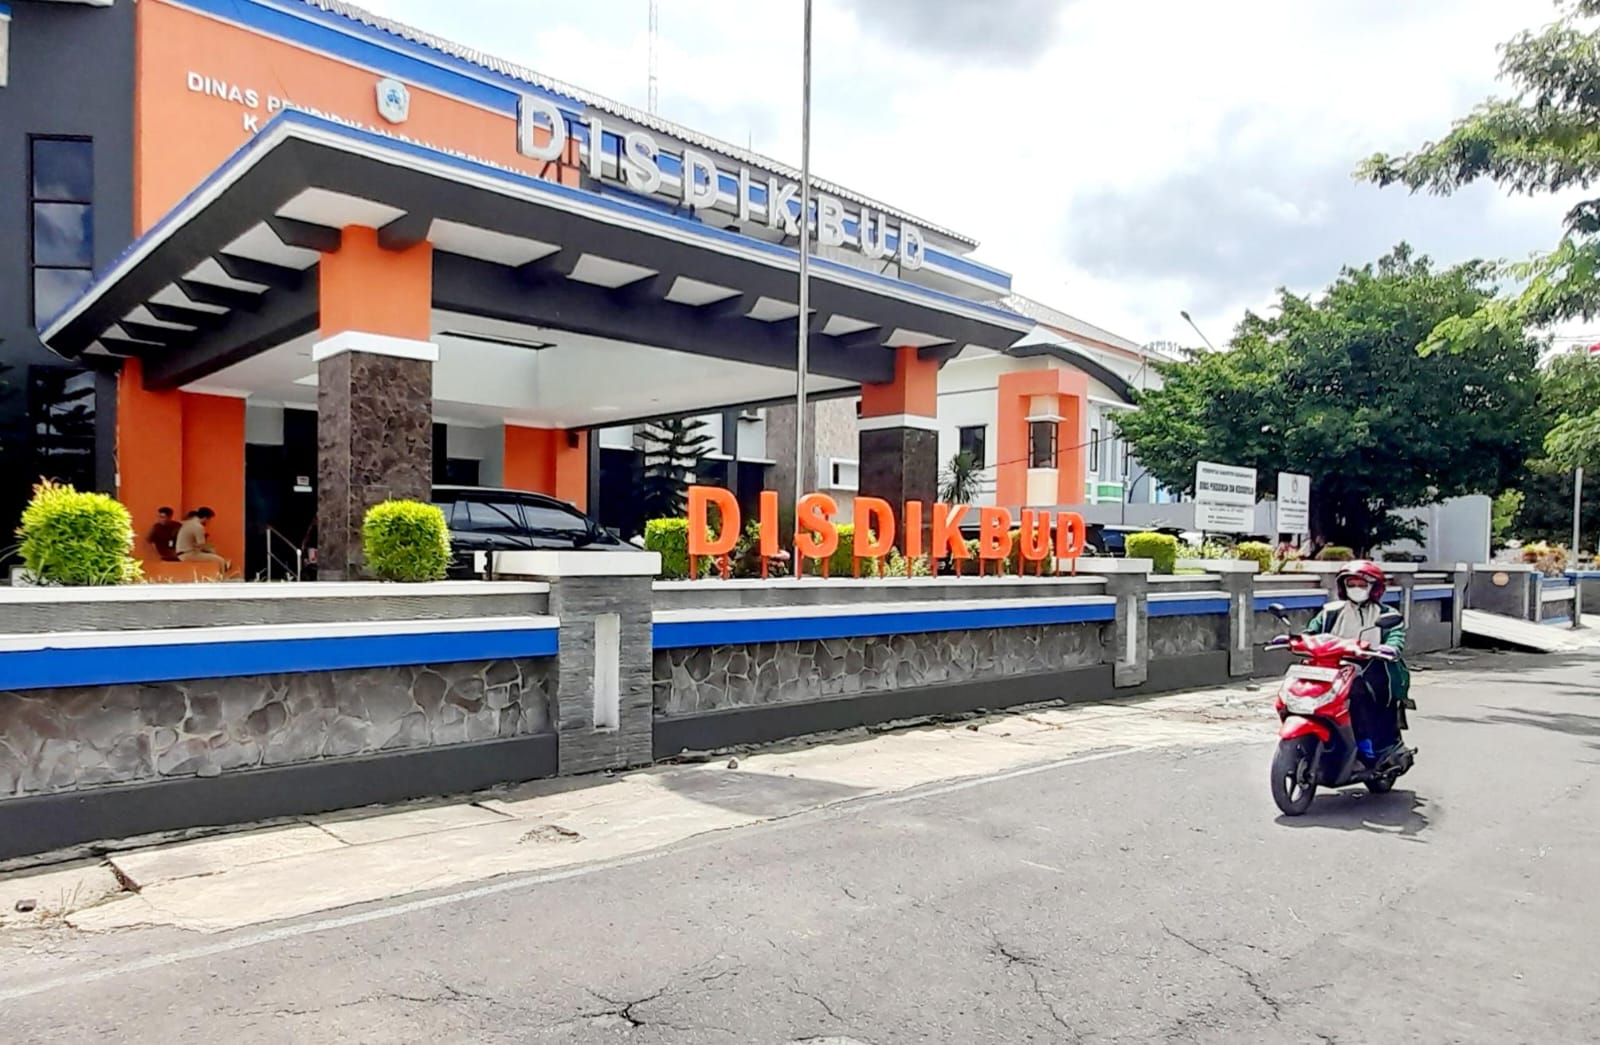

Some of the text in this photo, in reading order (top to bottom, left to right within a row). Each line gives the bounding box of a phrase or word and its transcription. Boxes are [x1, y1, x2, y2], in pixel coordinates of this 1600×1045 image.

[187, 71, 259, 109] DINAS
[518, 94, 925, 271] DISDIKBUD
[687, 485, 1087, 561] DISDIKBUD
